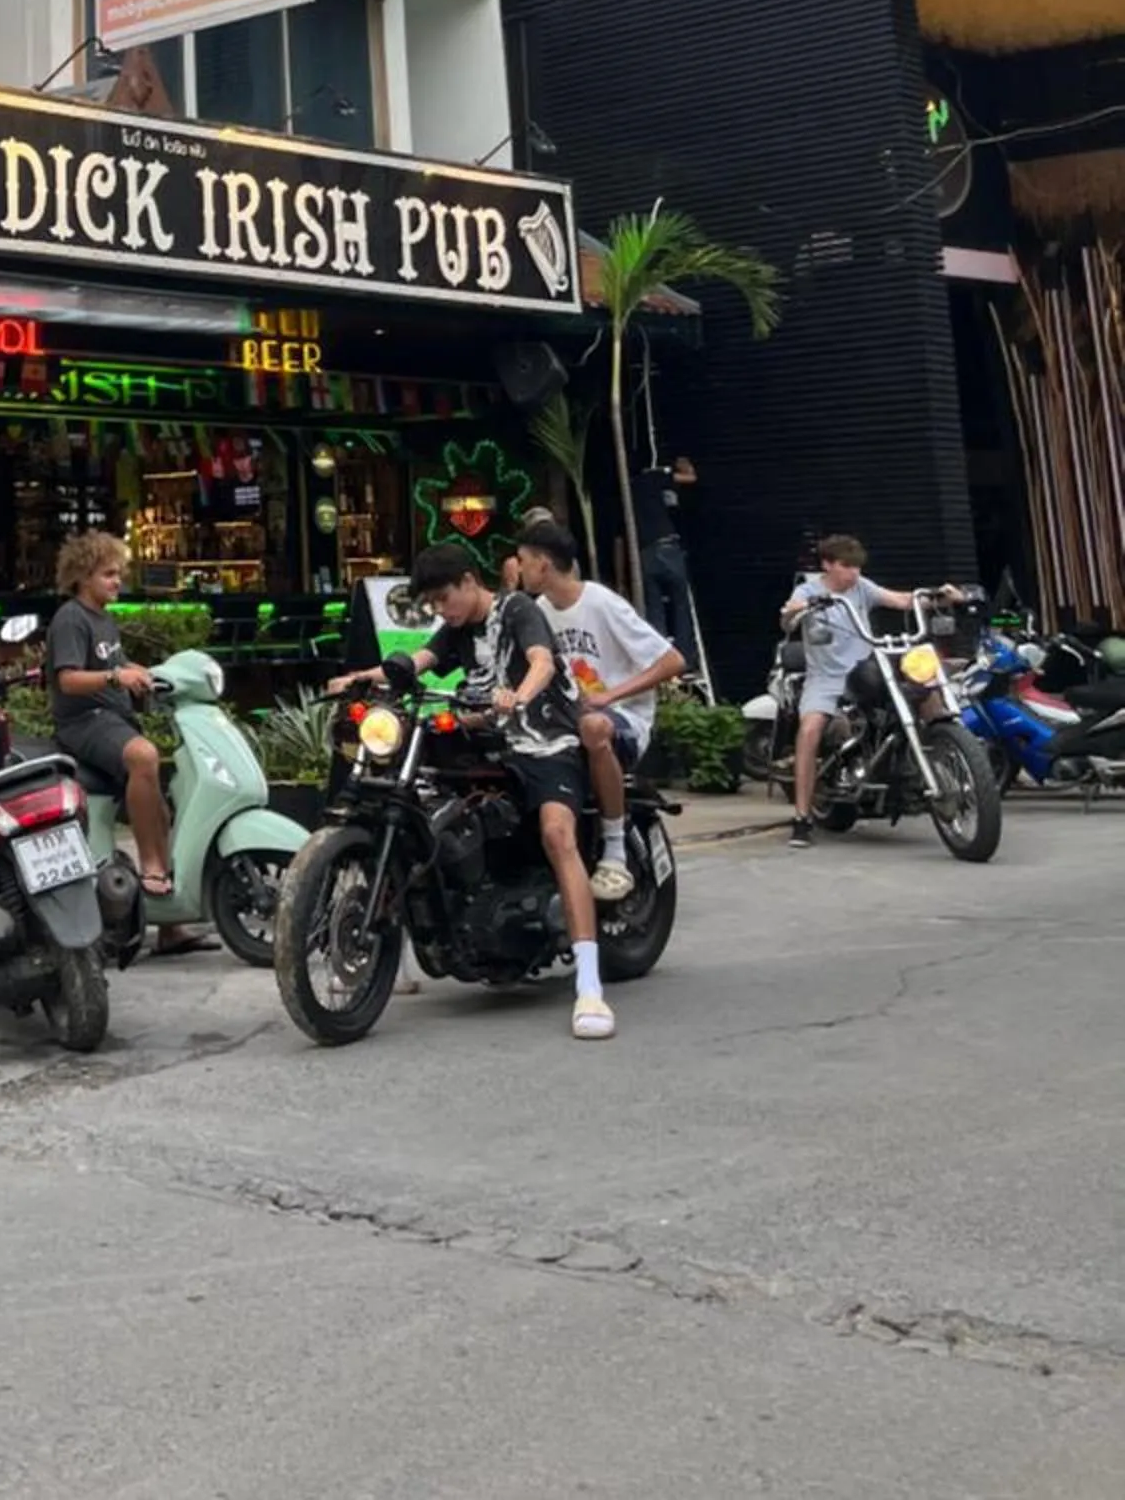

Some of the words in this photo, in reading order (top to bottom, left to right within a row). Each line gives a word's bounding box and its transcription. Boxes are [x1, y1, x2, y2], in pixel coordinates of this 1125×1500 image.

[195, 166, 375, 277] IRISH
[394, 195, 512, 291] PUB
[242, 339, 323, 374] BEER
